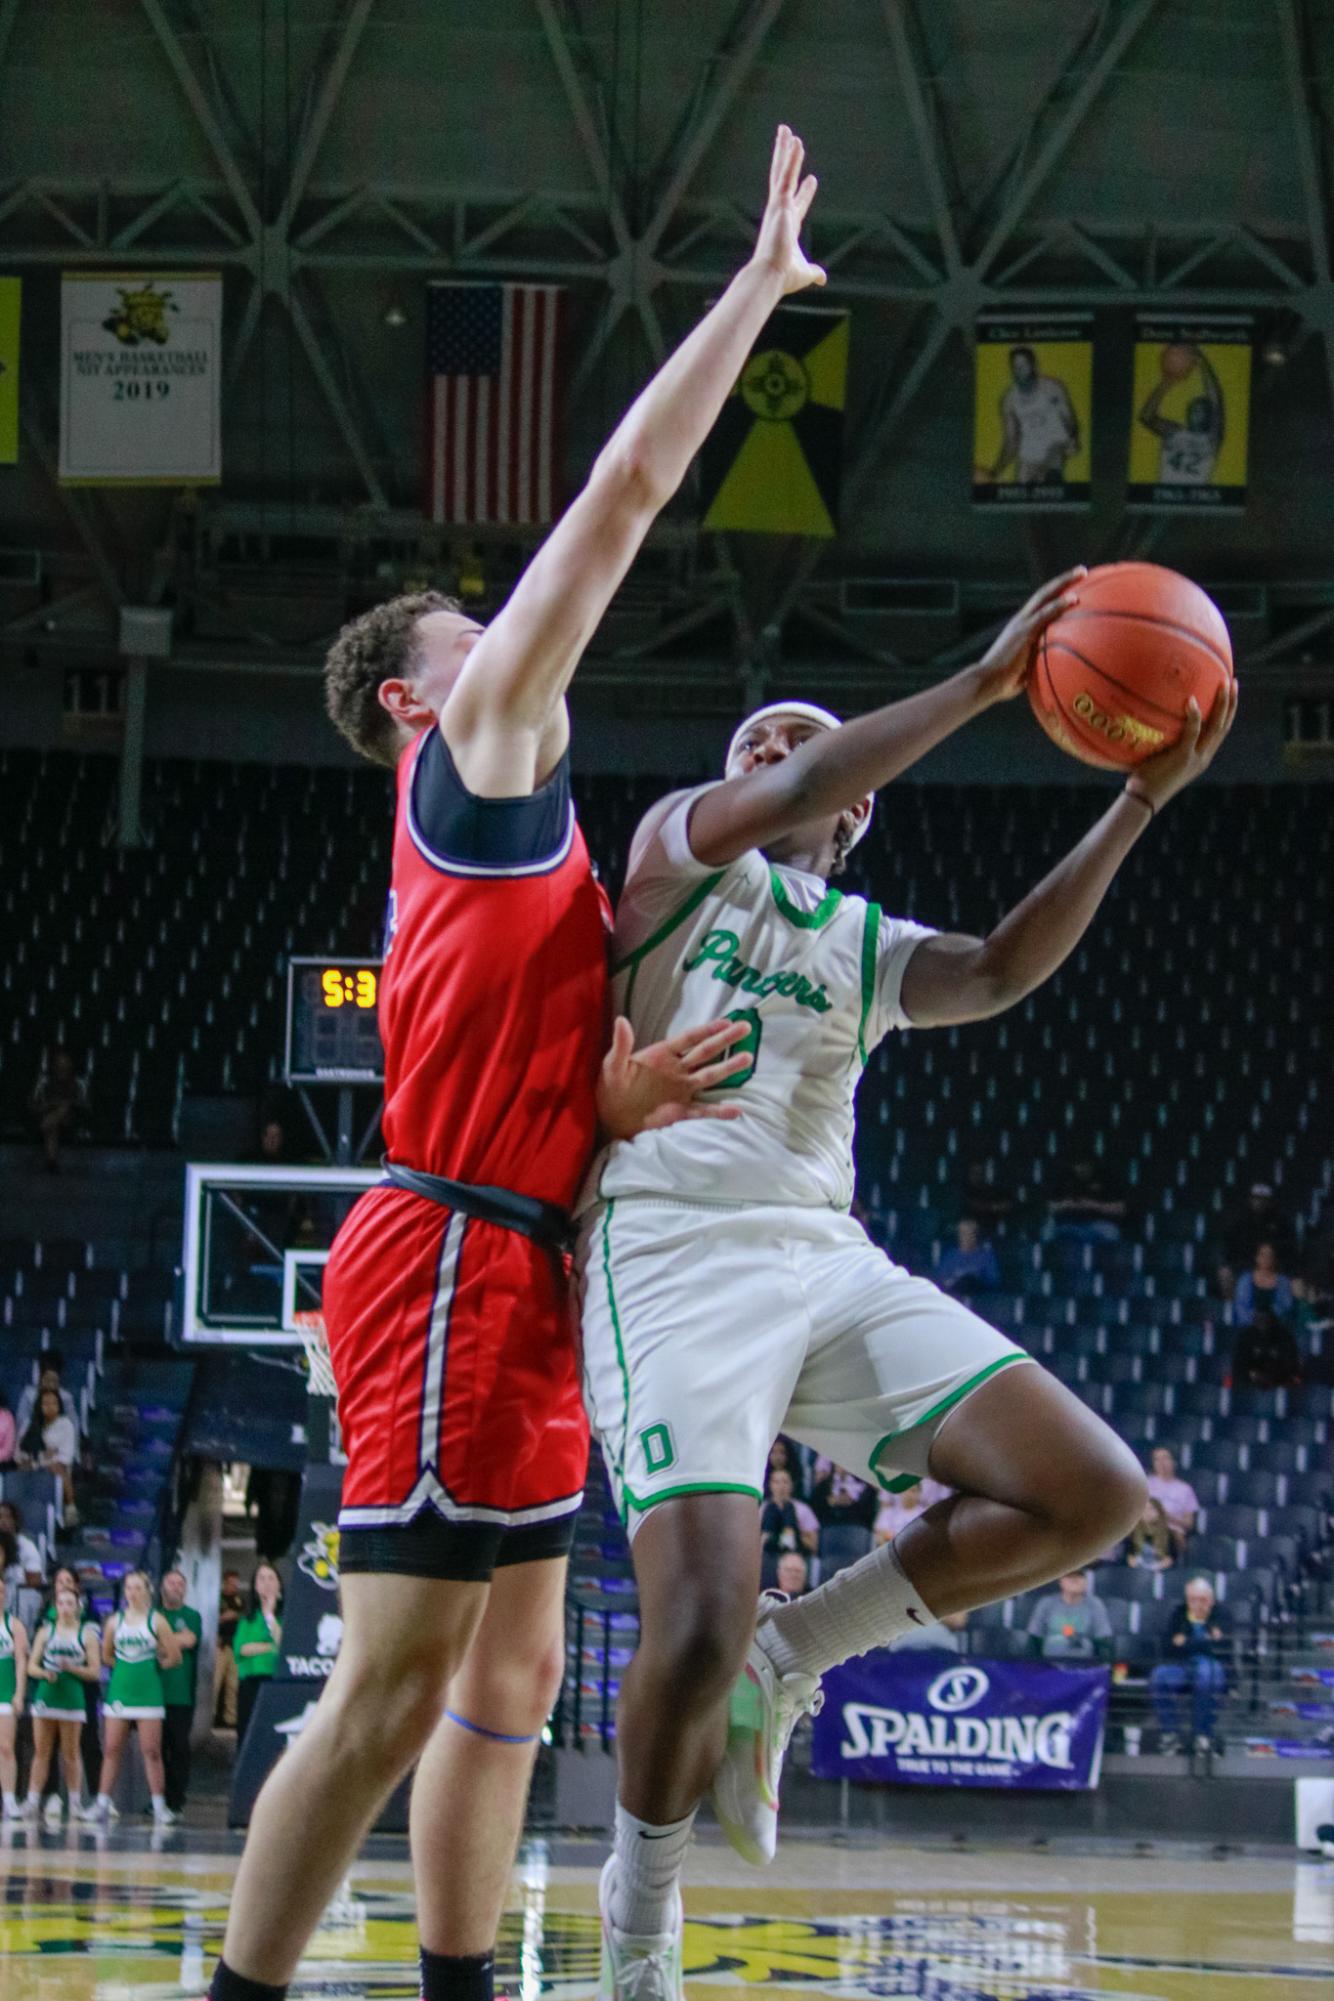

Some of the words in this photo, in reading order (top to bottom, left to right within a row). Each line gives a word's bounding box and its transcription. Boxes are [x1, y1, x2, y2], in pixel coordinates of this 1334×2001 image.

[113, 381, 169, 400] 2019
[1167, 450, 1202, 474] 42
[841, 1702, 1074, 1769] SPALDING
